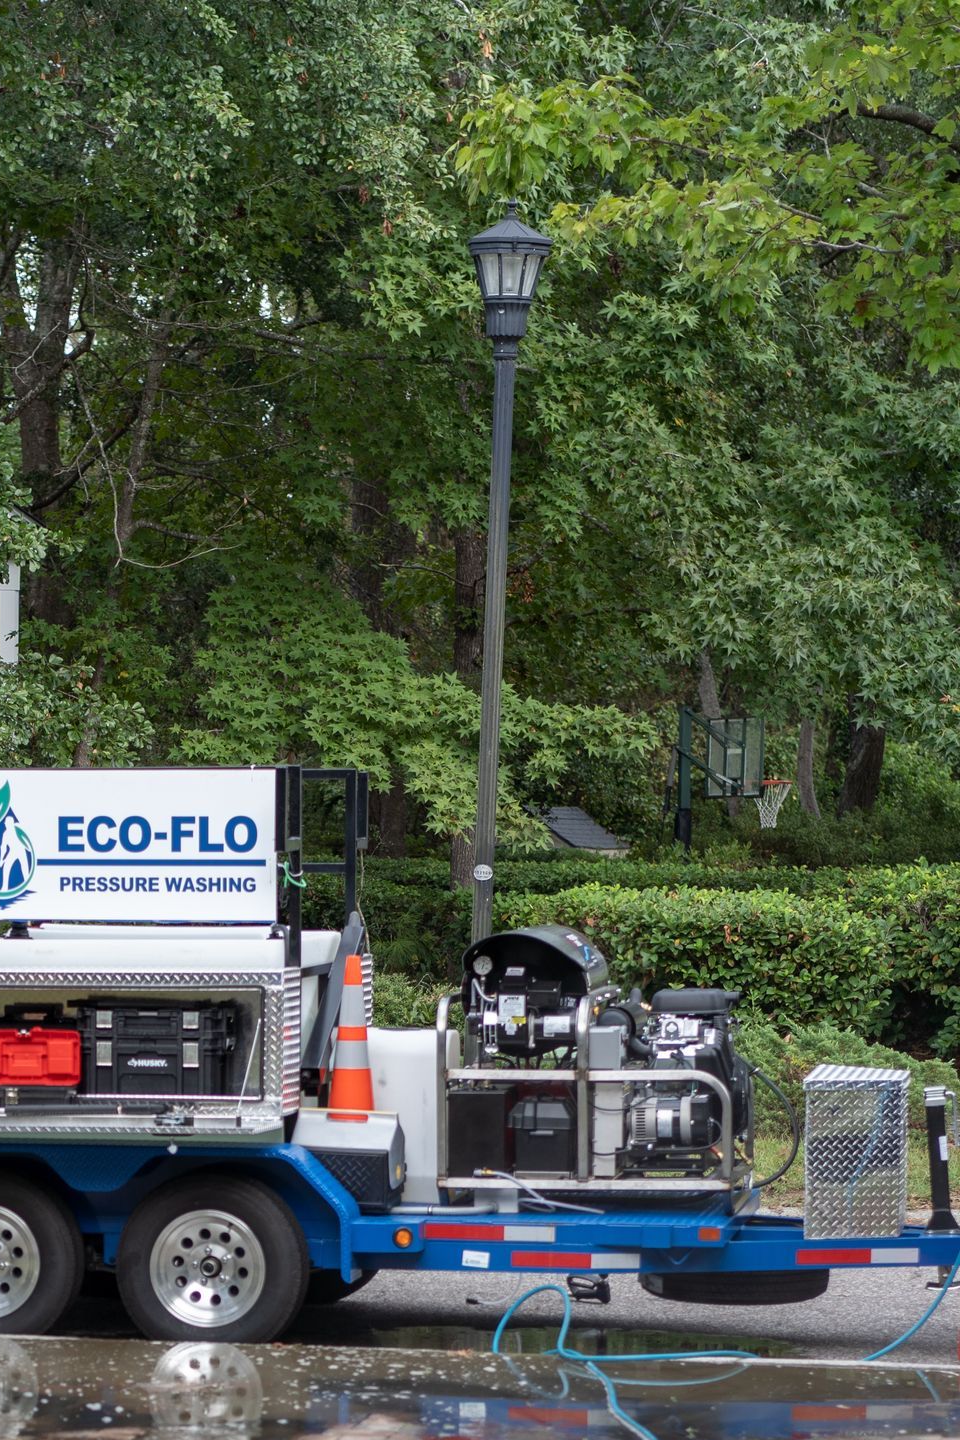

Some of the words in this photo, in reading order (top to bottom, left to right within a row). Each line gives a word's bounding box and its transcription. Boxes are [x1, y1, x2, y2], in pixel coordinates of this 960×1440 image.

[57, 815, 258, 854] ECO-FLO
[59, 876, 160, 893] PRESSURE
[165, 876, 257, 893] WASHING
[137, 1058, 167, 1068] HUSKY
